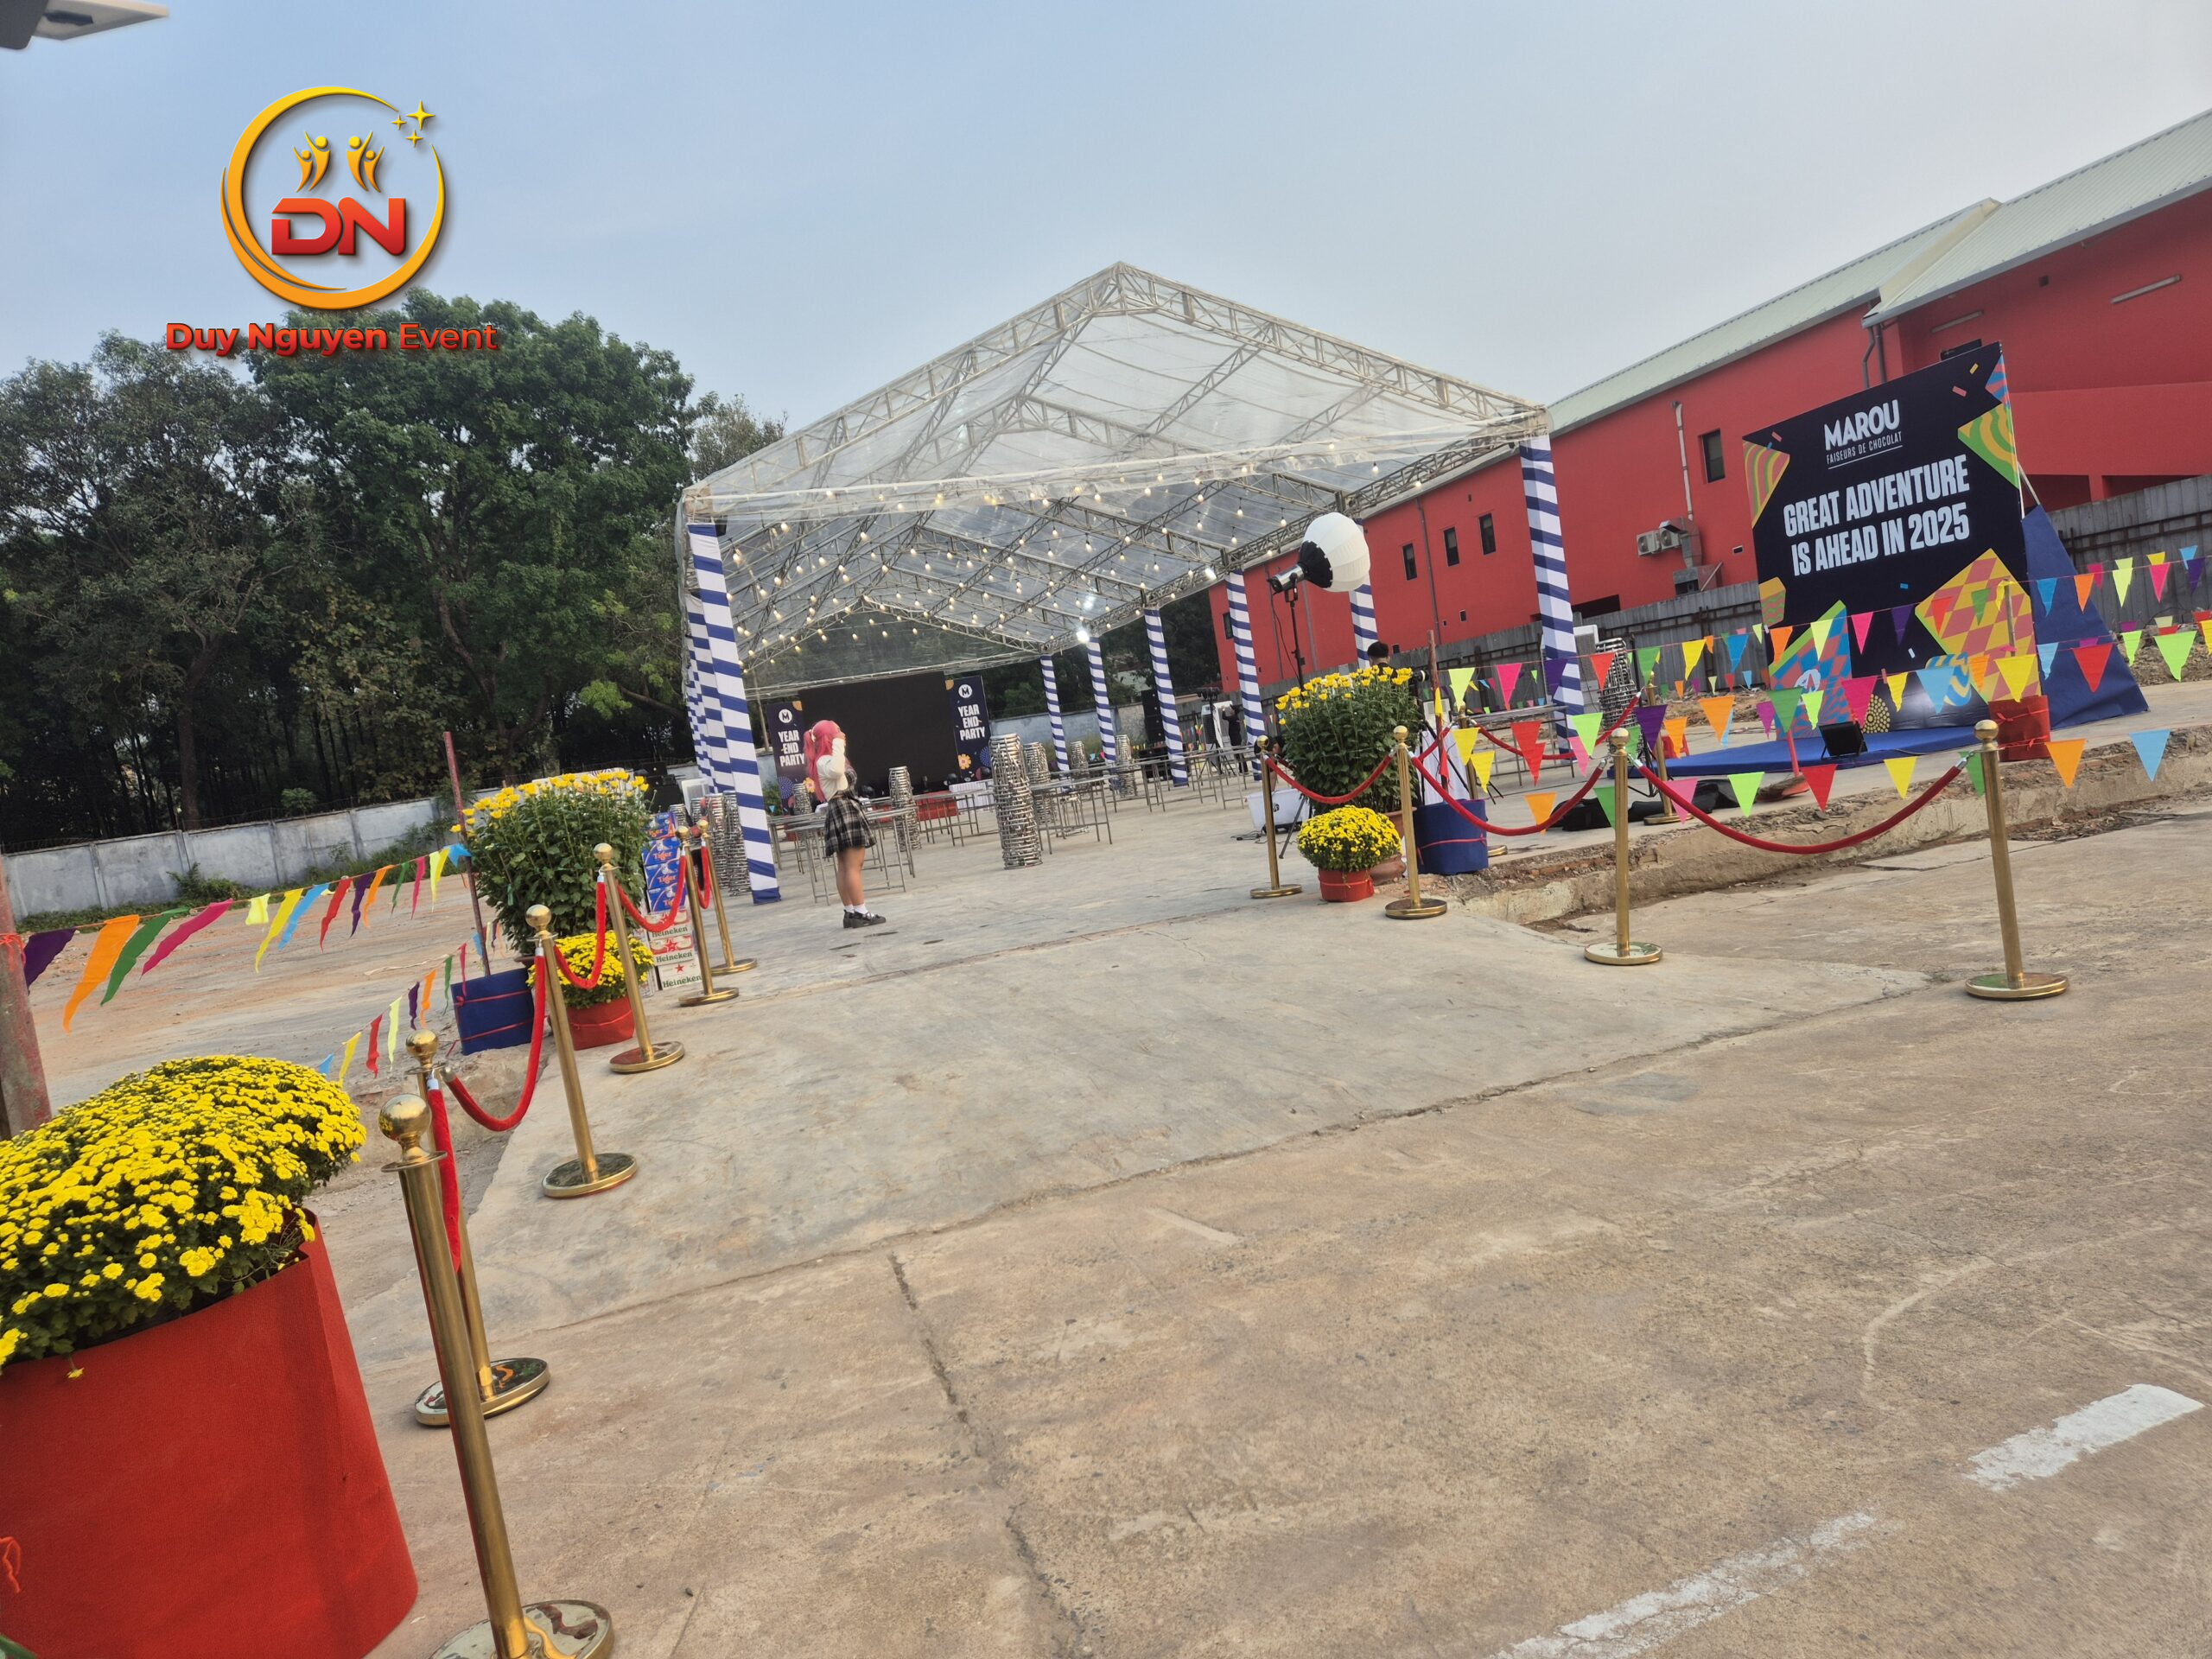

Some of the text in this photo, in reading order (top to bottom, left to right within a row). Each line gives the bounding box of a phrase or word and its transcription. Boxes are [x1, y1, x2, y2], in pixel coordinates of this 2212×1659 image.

[1824, 399, 1900, 451] MAROU
[1827, 431, 1902, 465] FAISEURS DE CHOCOLAT
[1783, 454, 1970, 537] GREAT ADVENTURE
[1790, 502, 1970, 576] IS AHEAD IN 2025
[957, 704, 980, 717] YEAR
[962, 717, 978, 729] END
[778, 730, 800, 743] YEAR
[959, 727, 985, 741] PARTY
[783, 742, 798, 754] END
[779, 753, 805, 766] PARTY
[653, 850, 672, 861] Tiger
[658, 873, 677, 885] Tiger
[656, 950, 692, 963] Heineken
[662, 974, 702, 988] Heineken
